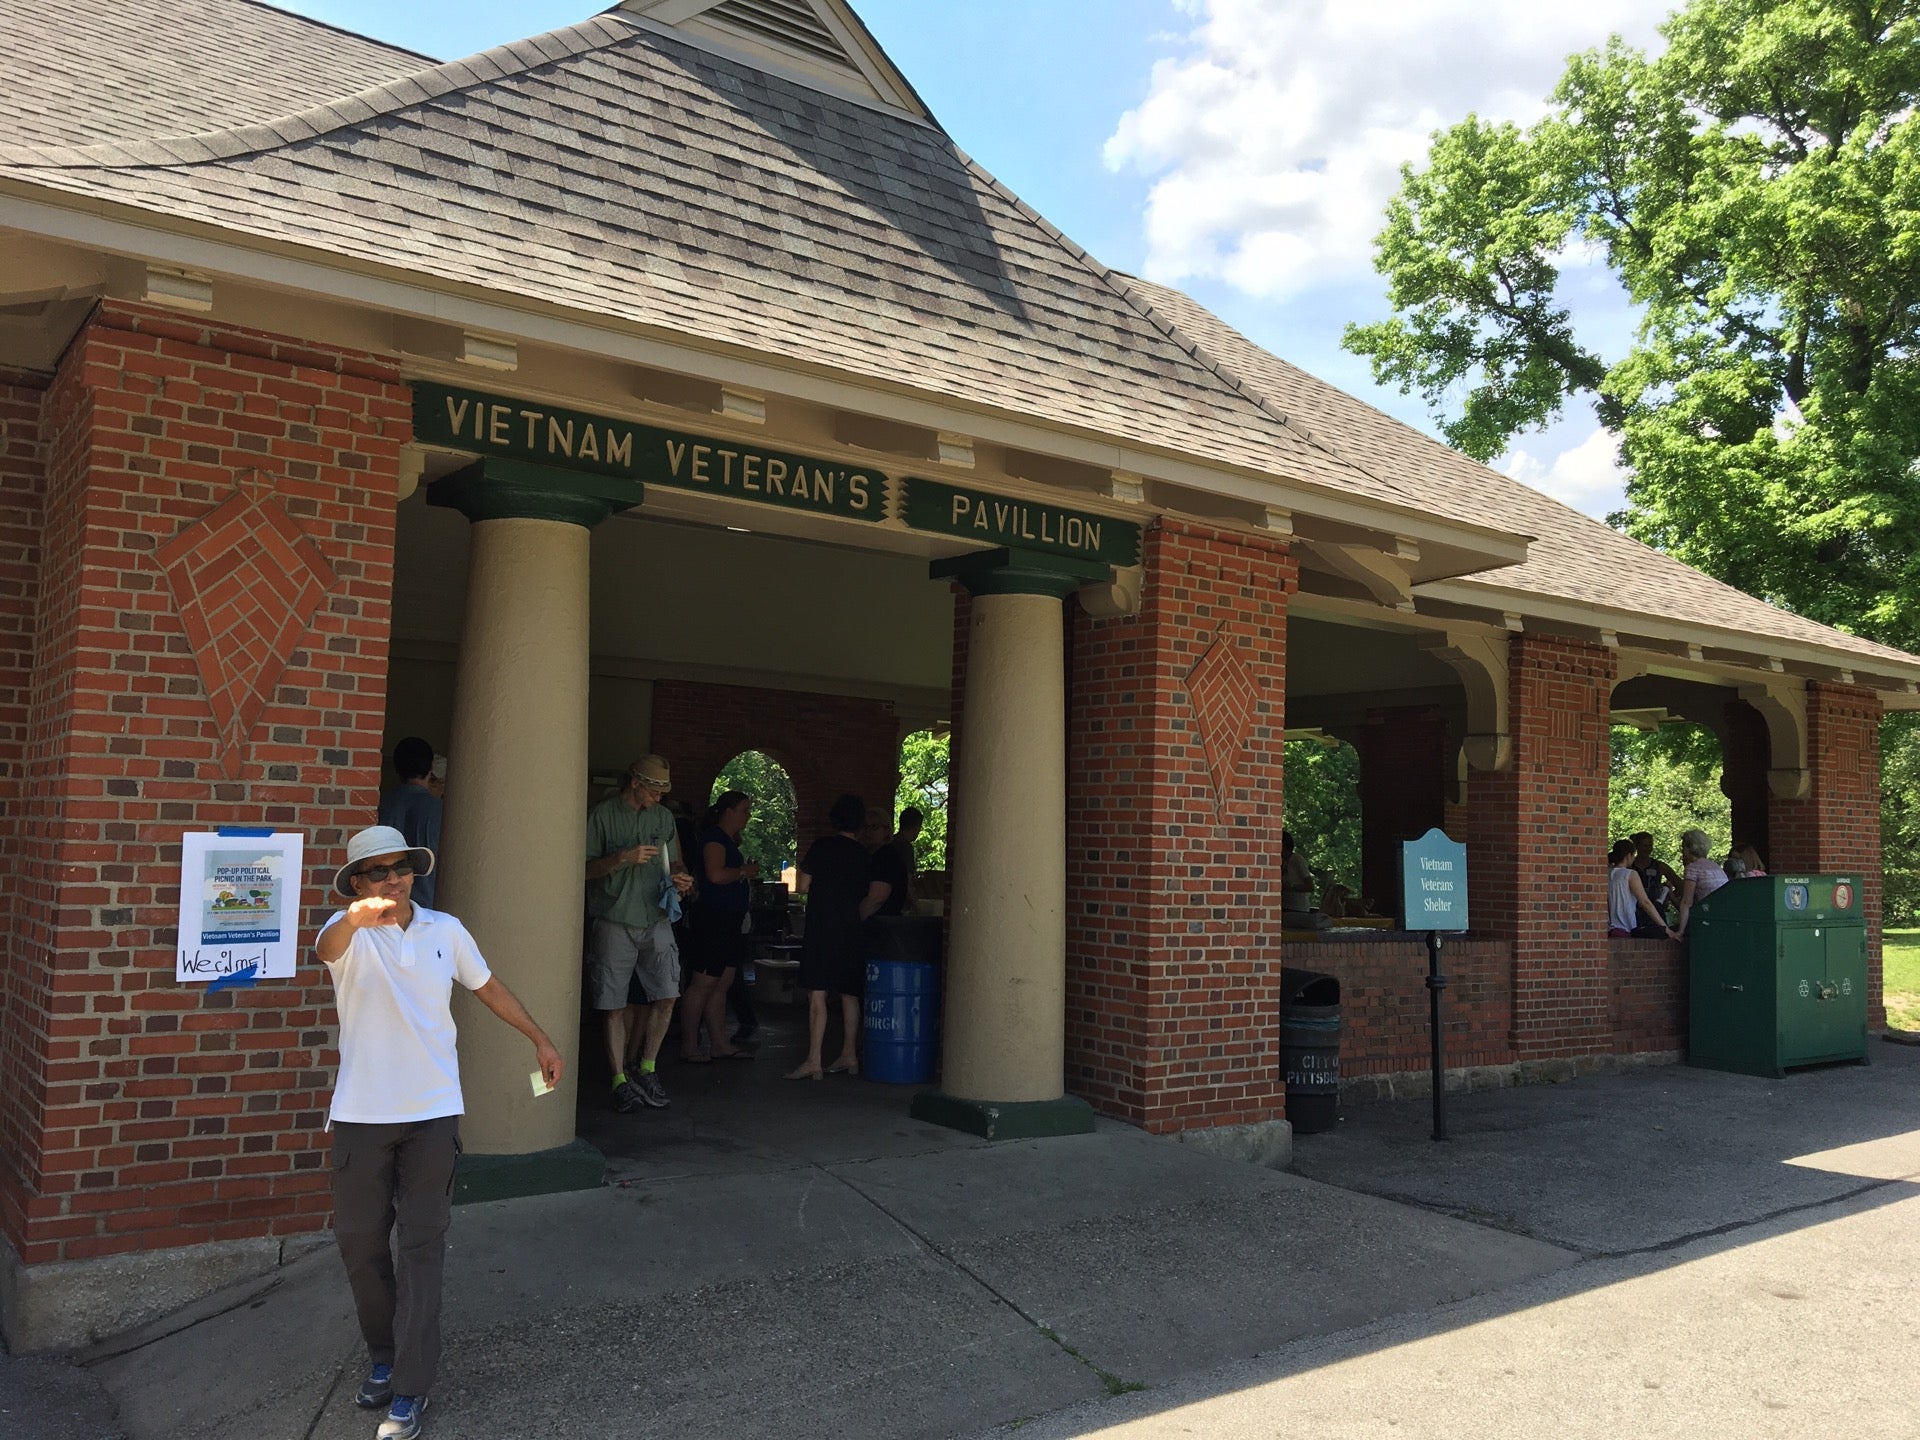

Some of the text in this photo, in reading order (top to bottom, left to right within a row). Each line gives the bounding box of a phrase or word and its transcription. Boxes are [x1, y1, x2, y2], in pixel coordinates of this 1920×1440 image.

[446, 396, 870, 510] VIETNAM VETERAN'S
[953, 495, 1100, 550] PAVILLION
[217, 867, 240, 875] POP-UP
[1421, 857, 1453, 871] Vietnam
[1421, 877, 1454, 891] Veterans
[1424, 897, 1452, 912] Shelter
[202, 932, 227, 940] Vietnam
[228, 931, 256, 939] Veteran's
[871, 999, 885, 1013] OF
[1302, 1055, 1330, 1069] CITY
